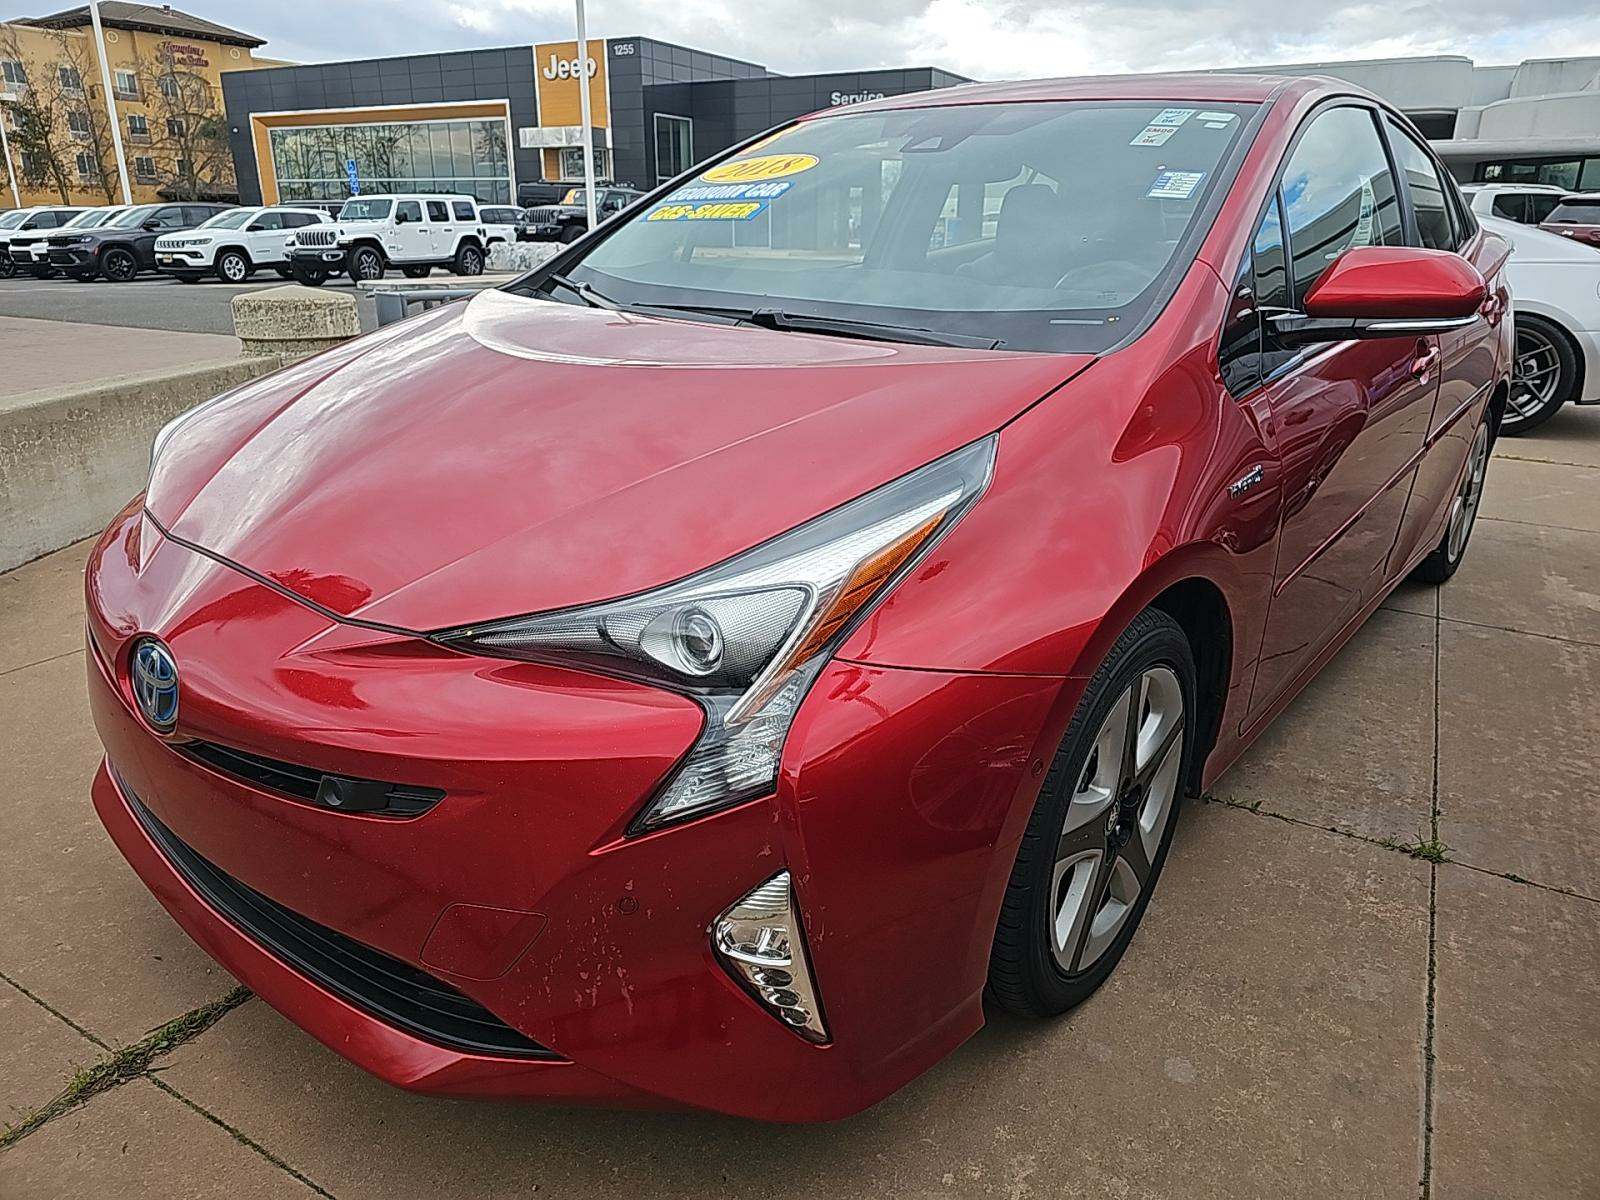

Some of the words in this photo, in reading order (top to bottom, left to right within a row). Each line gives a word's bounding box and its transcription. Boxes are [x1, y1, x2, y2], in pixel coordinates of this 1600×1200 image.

[613, 43, 635, 56] 1255
[543, 54, 596, 79] Jeep
[713, 157, 805, 179] 2018
[745, 180, 792, 198] CAR
